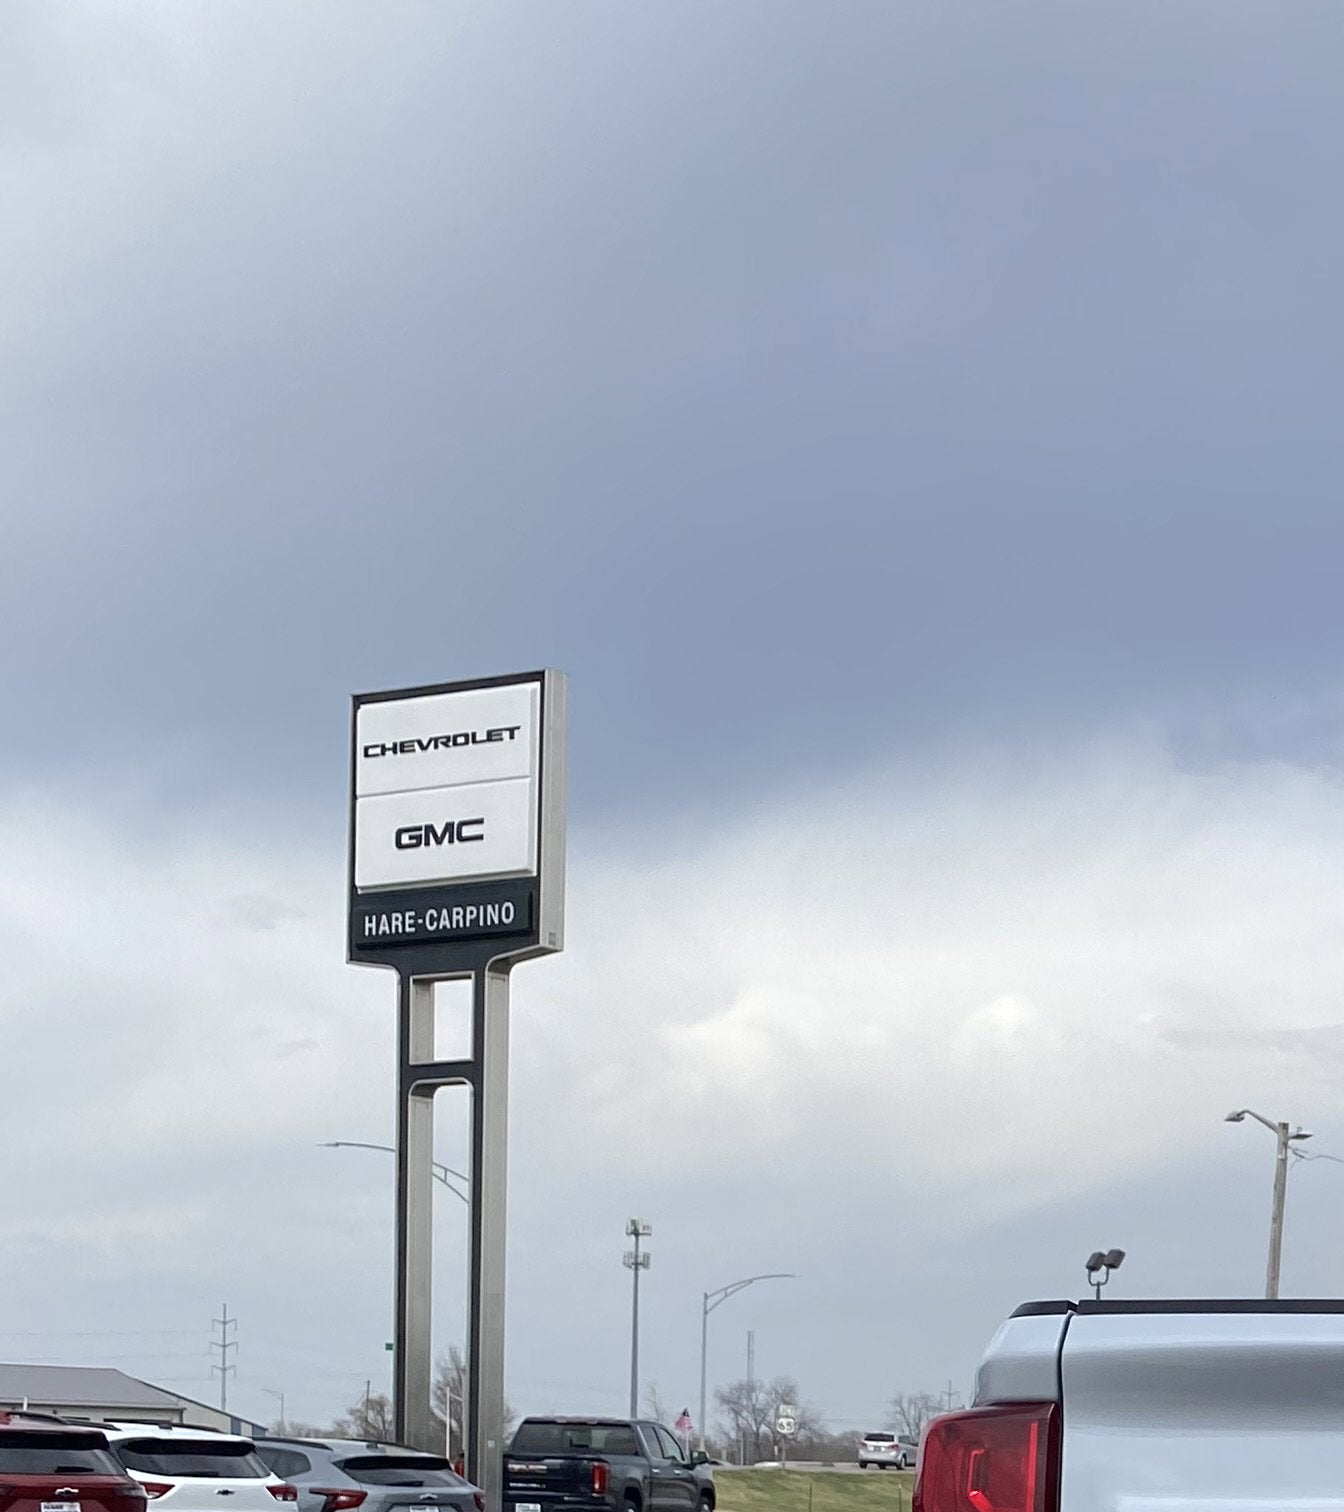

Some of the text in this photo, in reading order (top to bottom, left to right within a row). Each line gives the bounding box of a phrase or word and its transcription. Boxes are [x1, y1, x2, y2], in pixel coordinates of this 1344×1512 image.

[363, 725, 521, 758] CHEVROLET
[395, 817, 484, 850] GMC
[364, 901, 515, 937] HARE-CARPINO
